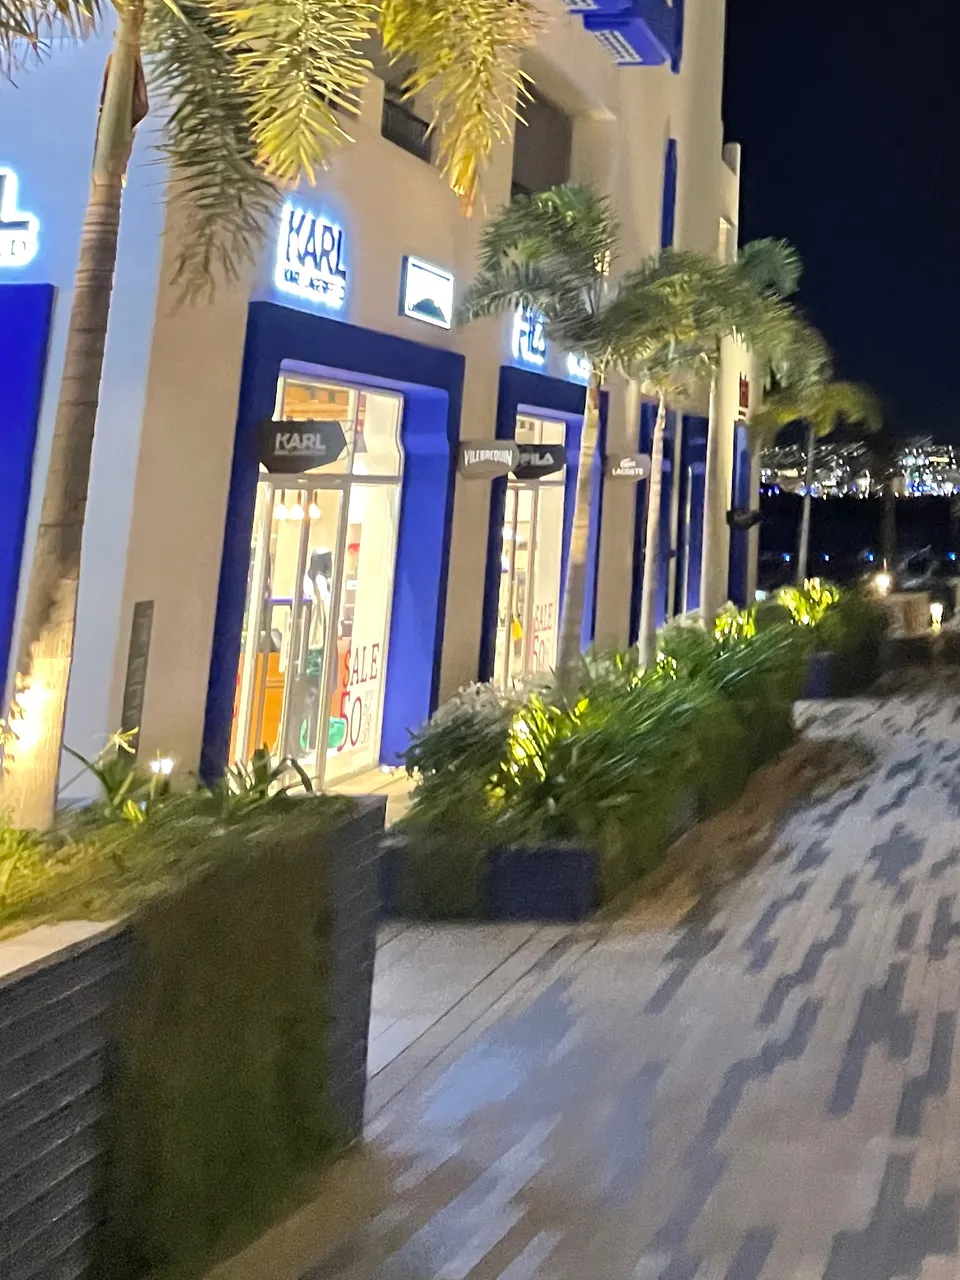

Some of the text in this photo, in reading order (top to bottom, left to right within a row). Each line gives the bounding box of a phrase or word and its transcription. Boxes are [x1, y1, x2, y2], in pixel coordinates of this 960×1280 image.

[286, 211, 346, 281] KARL
[275, 433, 327, 450] KARL
[464, 450, 513, 467] VILEBREQUIN
[519, 452, 554, 467] FILA
[612, 467, 643, 477] LACOSTE
[342, 642, 380, 689] SALE
